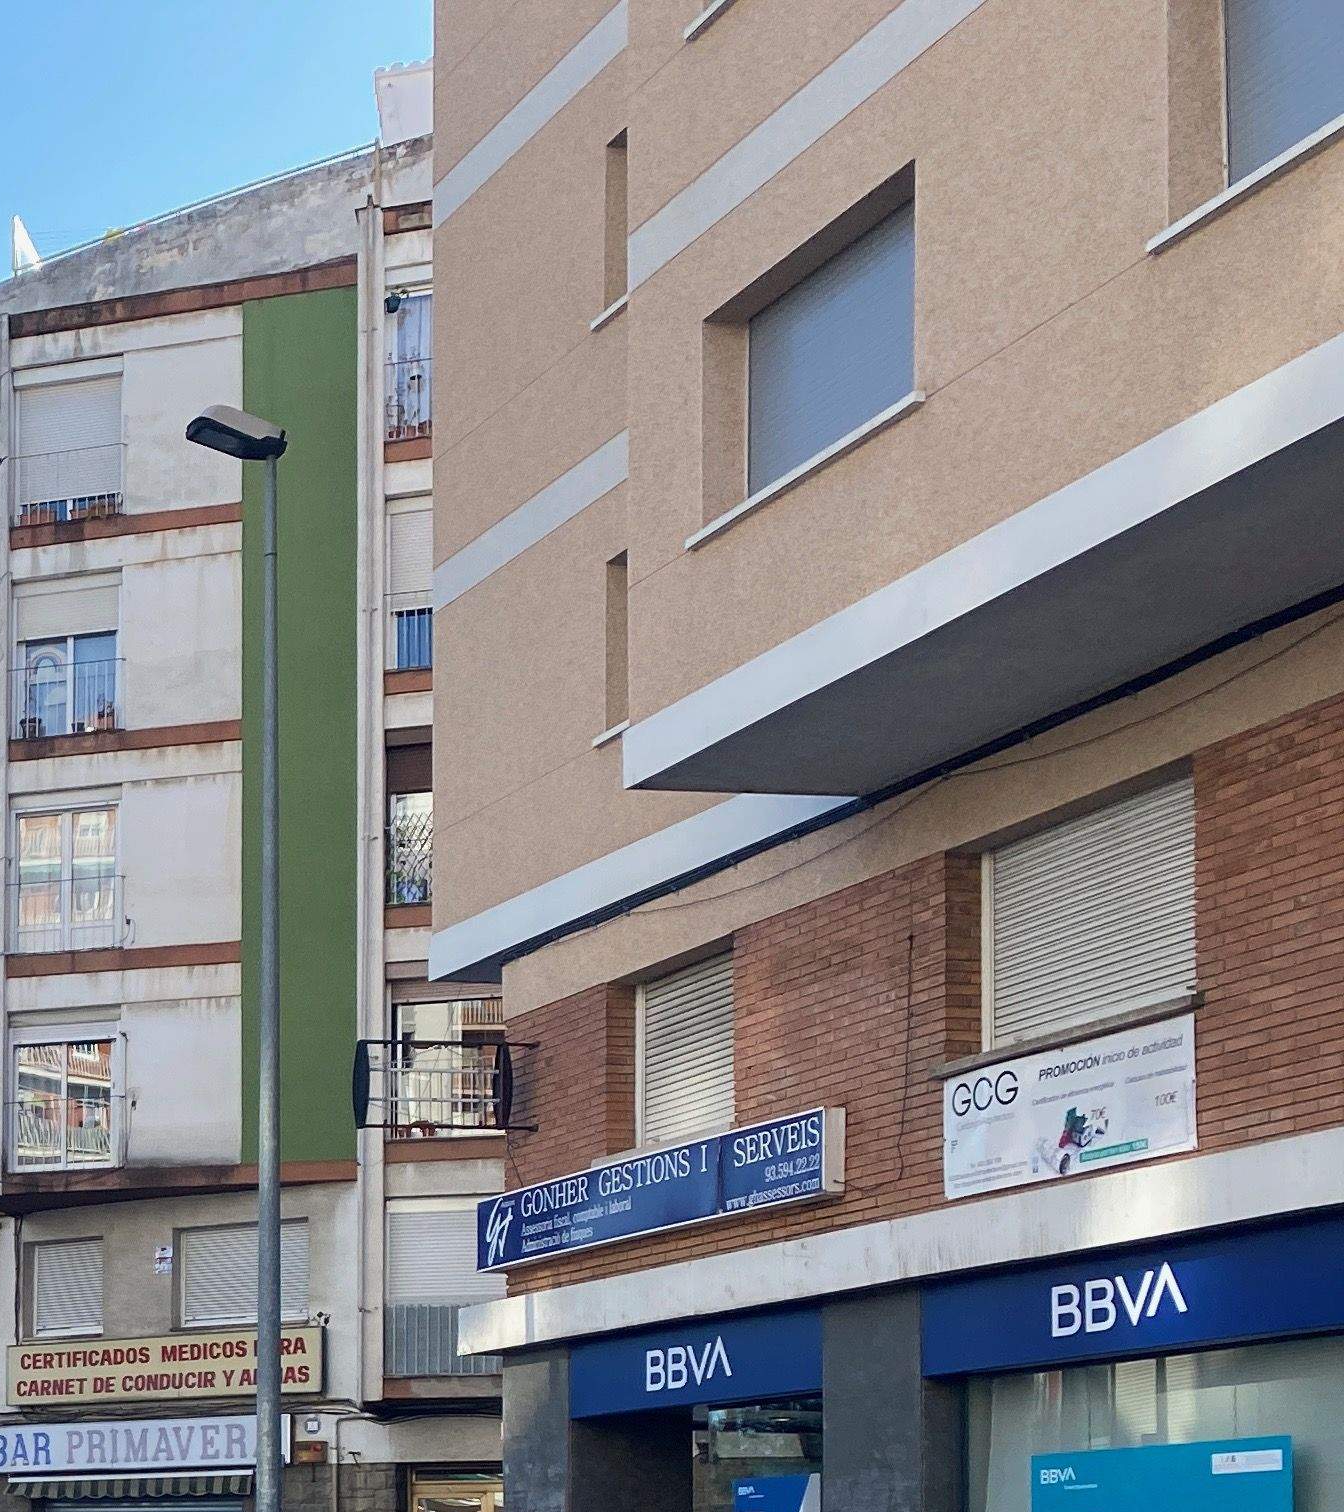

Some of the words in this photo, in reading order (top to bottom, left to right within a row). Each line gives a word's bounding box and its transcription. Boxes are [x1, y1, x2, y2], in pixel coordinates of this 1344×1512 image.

[952, 1070, 1019, 1117] GCG
[520, 1175, 590, 1218] GONHER
[598, 1148, 691, 1197] GESTIONS
[700, 1144, 708, 1173] I
[733, 1116, 820, 1168] SERVEIS
[1051, 1262, 1188, 1338] BBVA
[20, 1346, 150, 1370] CERTIFICADOS
[161, 1339, 248, 1363] MEDICOS
[645, 1335, 732, 1392] BBVA
[16, 1376, 87, 1398] CARNET
[92, 1375, 116, 1394] DE
[121, 1370, 216, 1392] CONDUCIR
[222, 1369, 235, 1387] Y
[238, 1365, 310, 1388] AAS
[65, 1422, 257, 1466] PRIMAVER
[1040, 1466, 1077, 1485] BBVA
